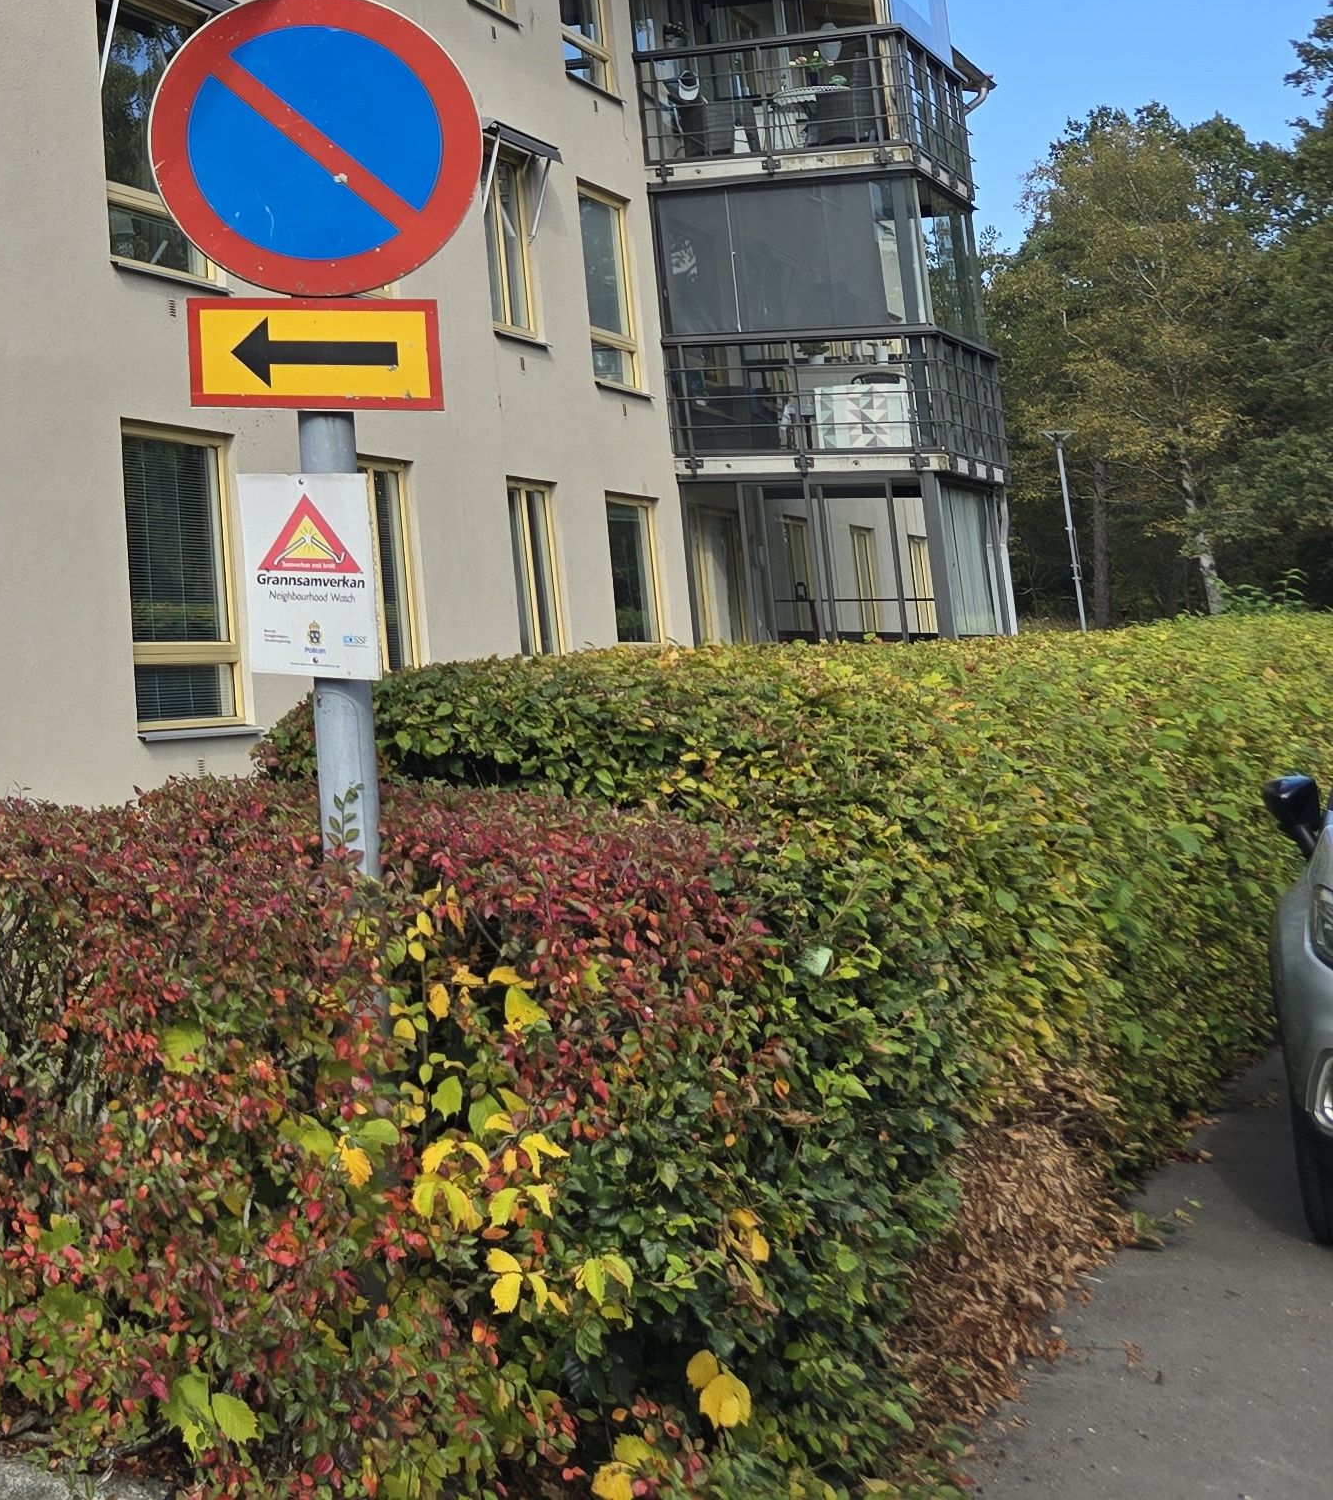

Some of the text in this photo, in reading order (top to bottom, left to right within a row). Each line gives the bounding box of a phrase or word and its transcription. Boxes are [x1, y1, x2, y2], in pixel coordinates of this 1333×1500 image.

[257, 573, 366, 589] Grannsamverkan
[269, 590, 356, 603] Neighbourhood Watch
